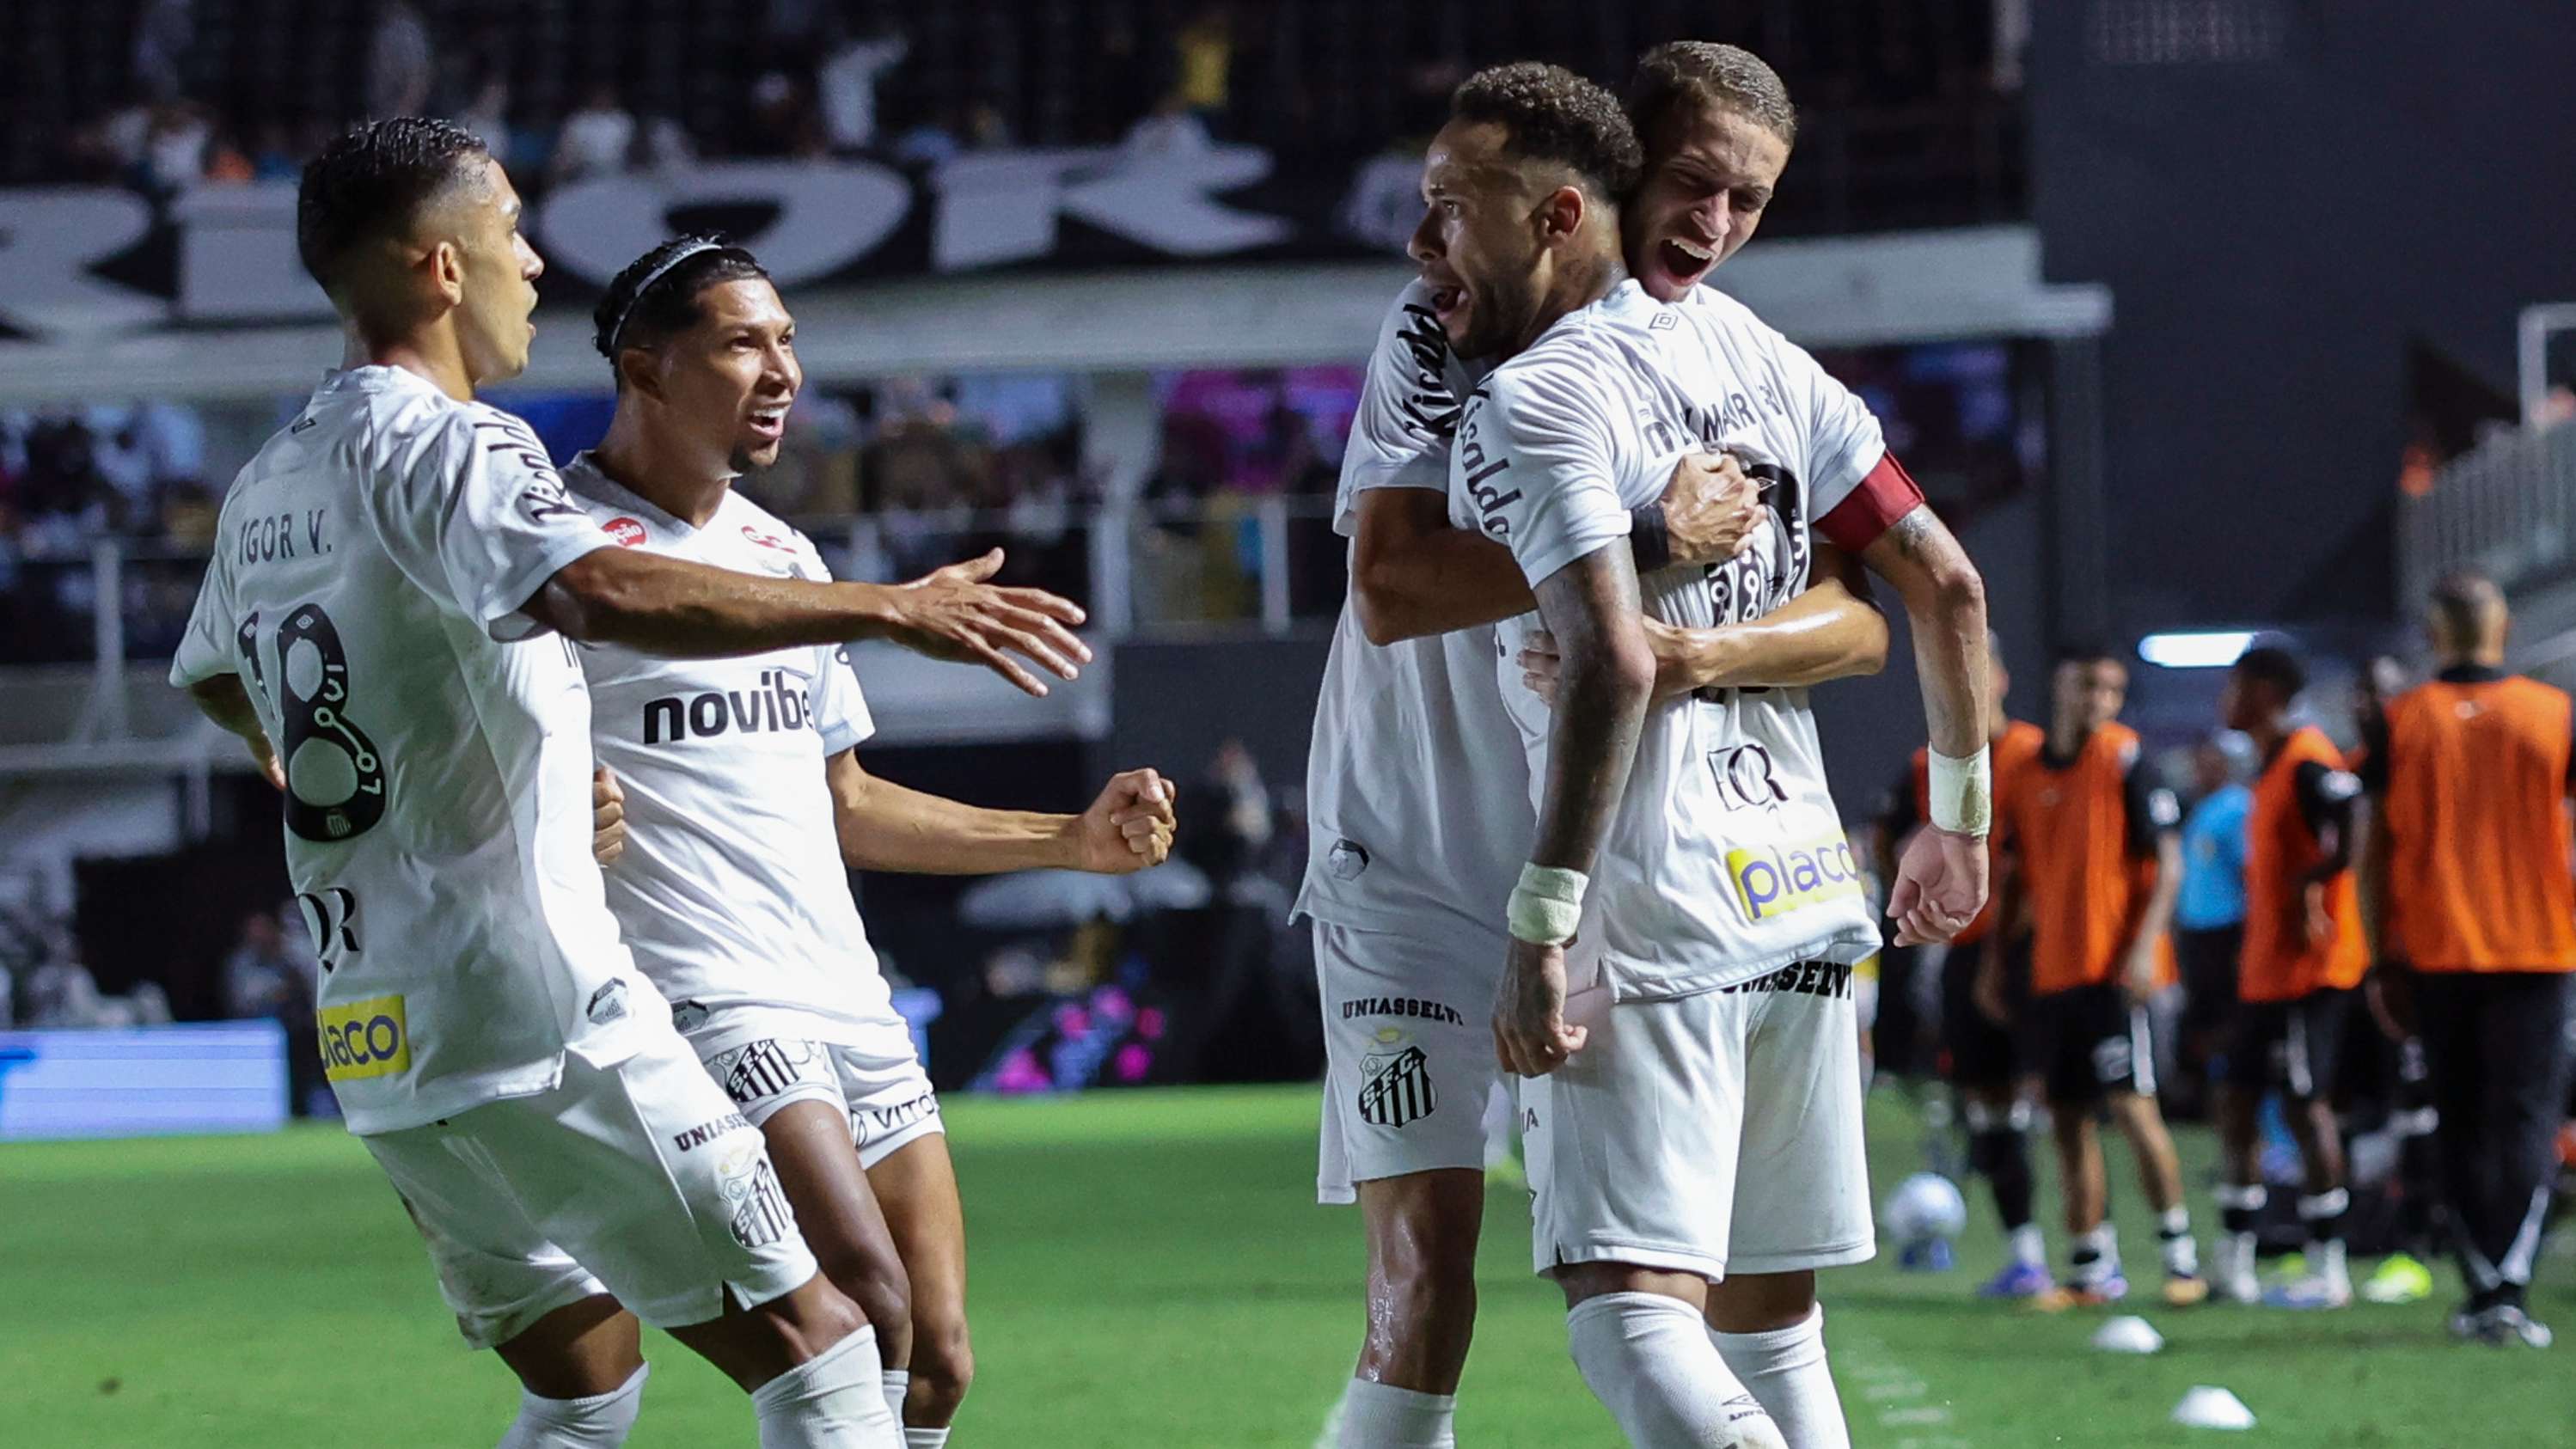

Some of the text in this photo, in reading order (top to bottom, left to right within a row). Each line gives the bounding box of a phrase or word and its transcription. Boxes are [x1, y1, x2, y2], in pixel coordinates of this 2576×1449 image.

[239, 509, 332, 566] IGOR V.
[873, 1089, 940, 1129] VITÓ
